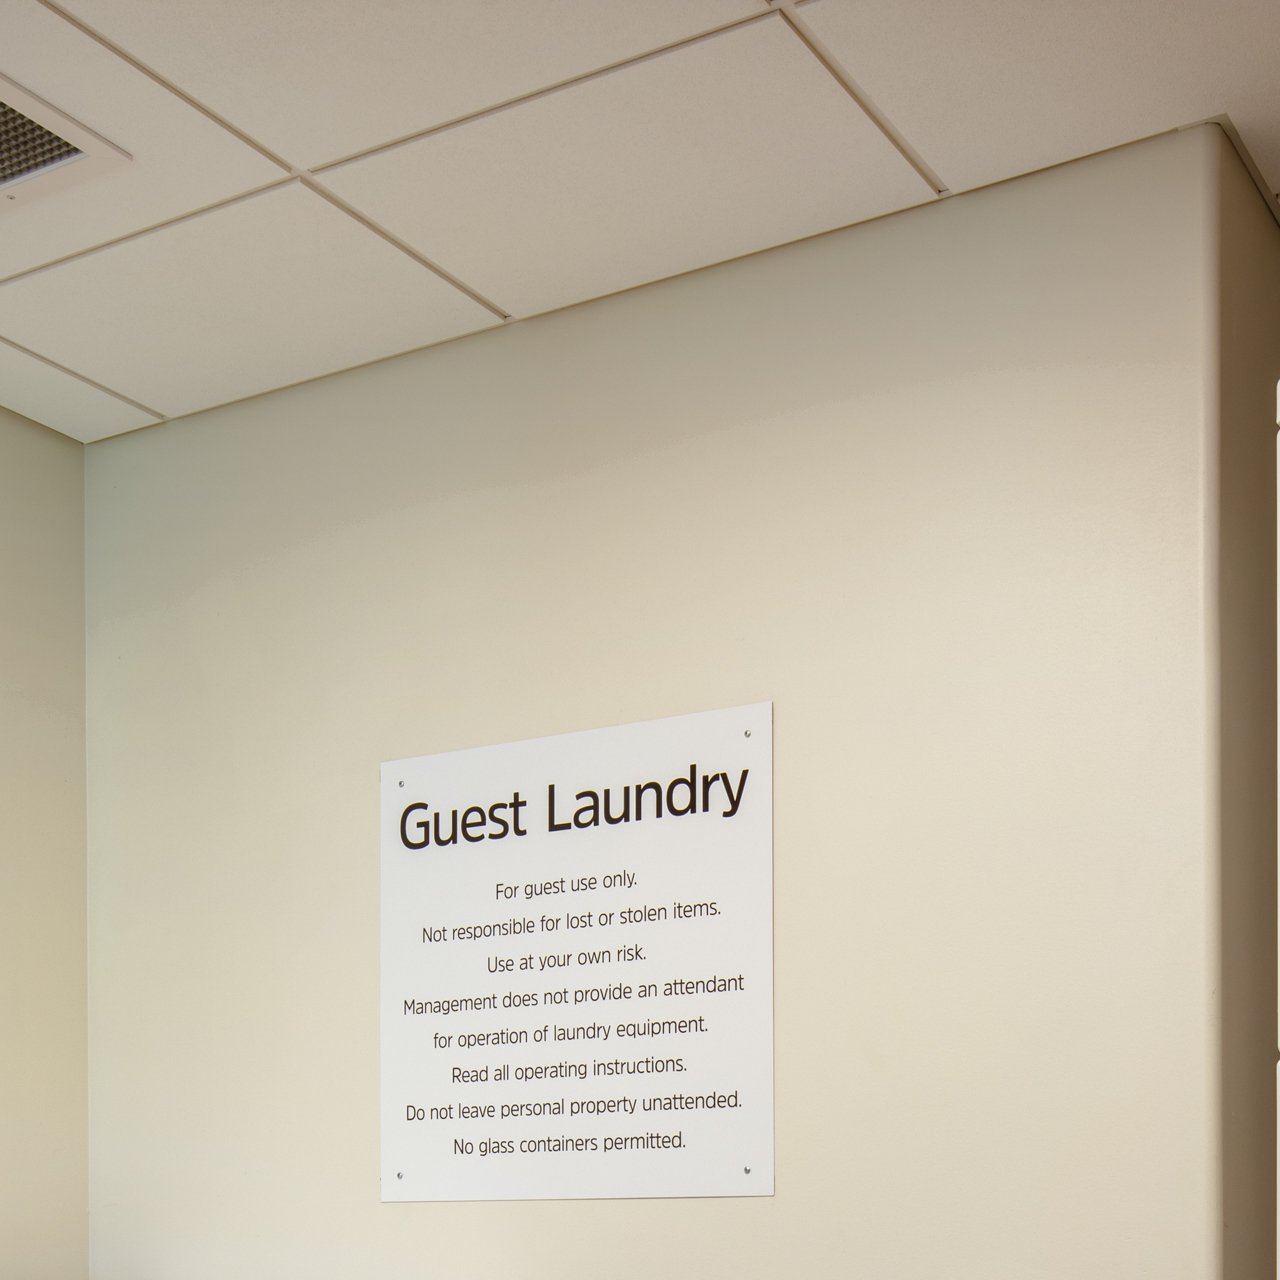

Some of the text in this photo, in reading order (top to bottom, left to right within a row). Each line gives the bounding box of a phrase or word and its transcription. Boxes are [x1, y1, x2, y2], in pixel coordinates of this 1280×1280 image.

[400, 764, 749, 850] Guest Laundry
[496, 870, 637, 900] For guest use only.
[423, 902, 720, 943] Not responsible for lost or stolen items.
[488, 944, 646, 973] Use at your own risk.
[404, 974, 744, 1015] Management does not provide an attendant
[434, 1016, 708, 1048] for operation of laundry equipment.
[453, 1056, 687, 1083] Read all operating instructions.
[407, 1090, 741, 1121] Do not leave personal property unattended.
[454, 1131, 685, 1156] No glass containers permitted.
